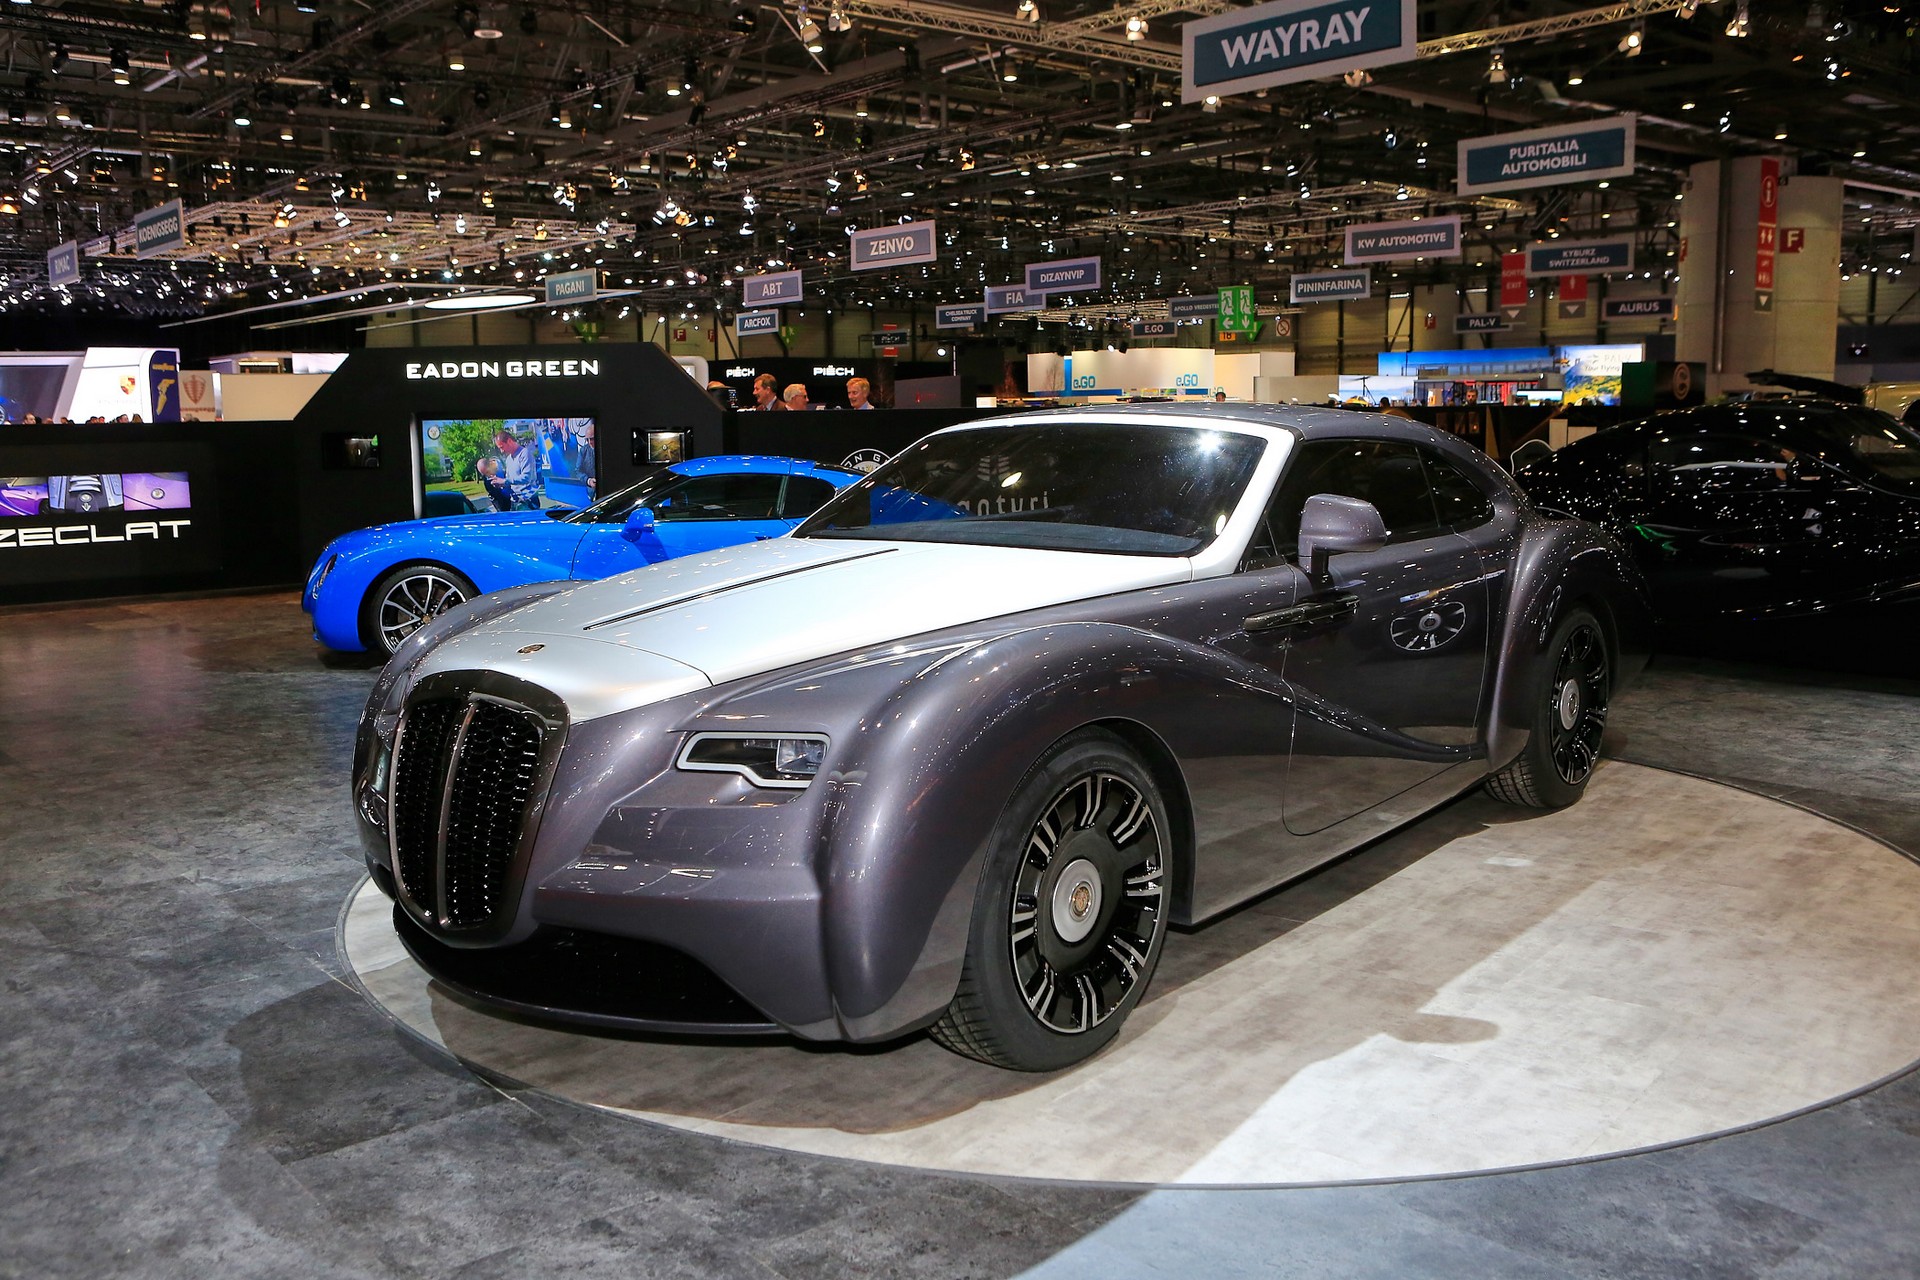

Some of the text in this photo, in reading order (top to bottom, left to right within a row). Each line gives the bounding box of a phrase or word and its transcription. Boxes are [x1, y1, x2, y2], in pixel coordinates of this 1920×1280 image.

[1221, 7, 1371, 69] WAYRAY
[1509, 139, 1580, 160] PURITALIA
[1501, 153, 1587, 176] AUTOMOBILI
[138, 216, 178, 244] KOENIGSEGG
[869, 235, 915, 257] ZENVO
[1358, 232, 1447, 249] KW AUTOMOTIVE
[1787, 230, 1799, 248] F
[1562, 248, 1596, 258] KYBURZ
[1549, 256, 1610, 268] SWITZERLAND
[1040, 269, 1085, 284] DIZAYNVIP
[555, 279, 586, 296] PAGANI
[762, 281, 783, 297] ABT
[1297, 279, 1363, 293] PININFARINA
[1506, 281, 1522, 290] EXIT
[1005, 291, 1024, 305] FIA
[1618, 301, 1660, 313] AURUS
[744, 316, 771, 329] ARCFOX
[1144, 324, 1164, 333] E.GO
[1469, 317, 1496, 328] PAL-V
[406, 360, 599, 380] EADON GREEN
[1073, 375, 1096, 389] e.GO
[1176, 374, 1198, 387] e.GO
